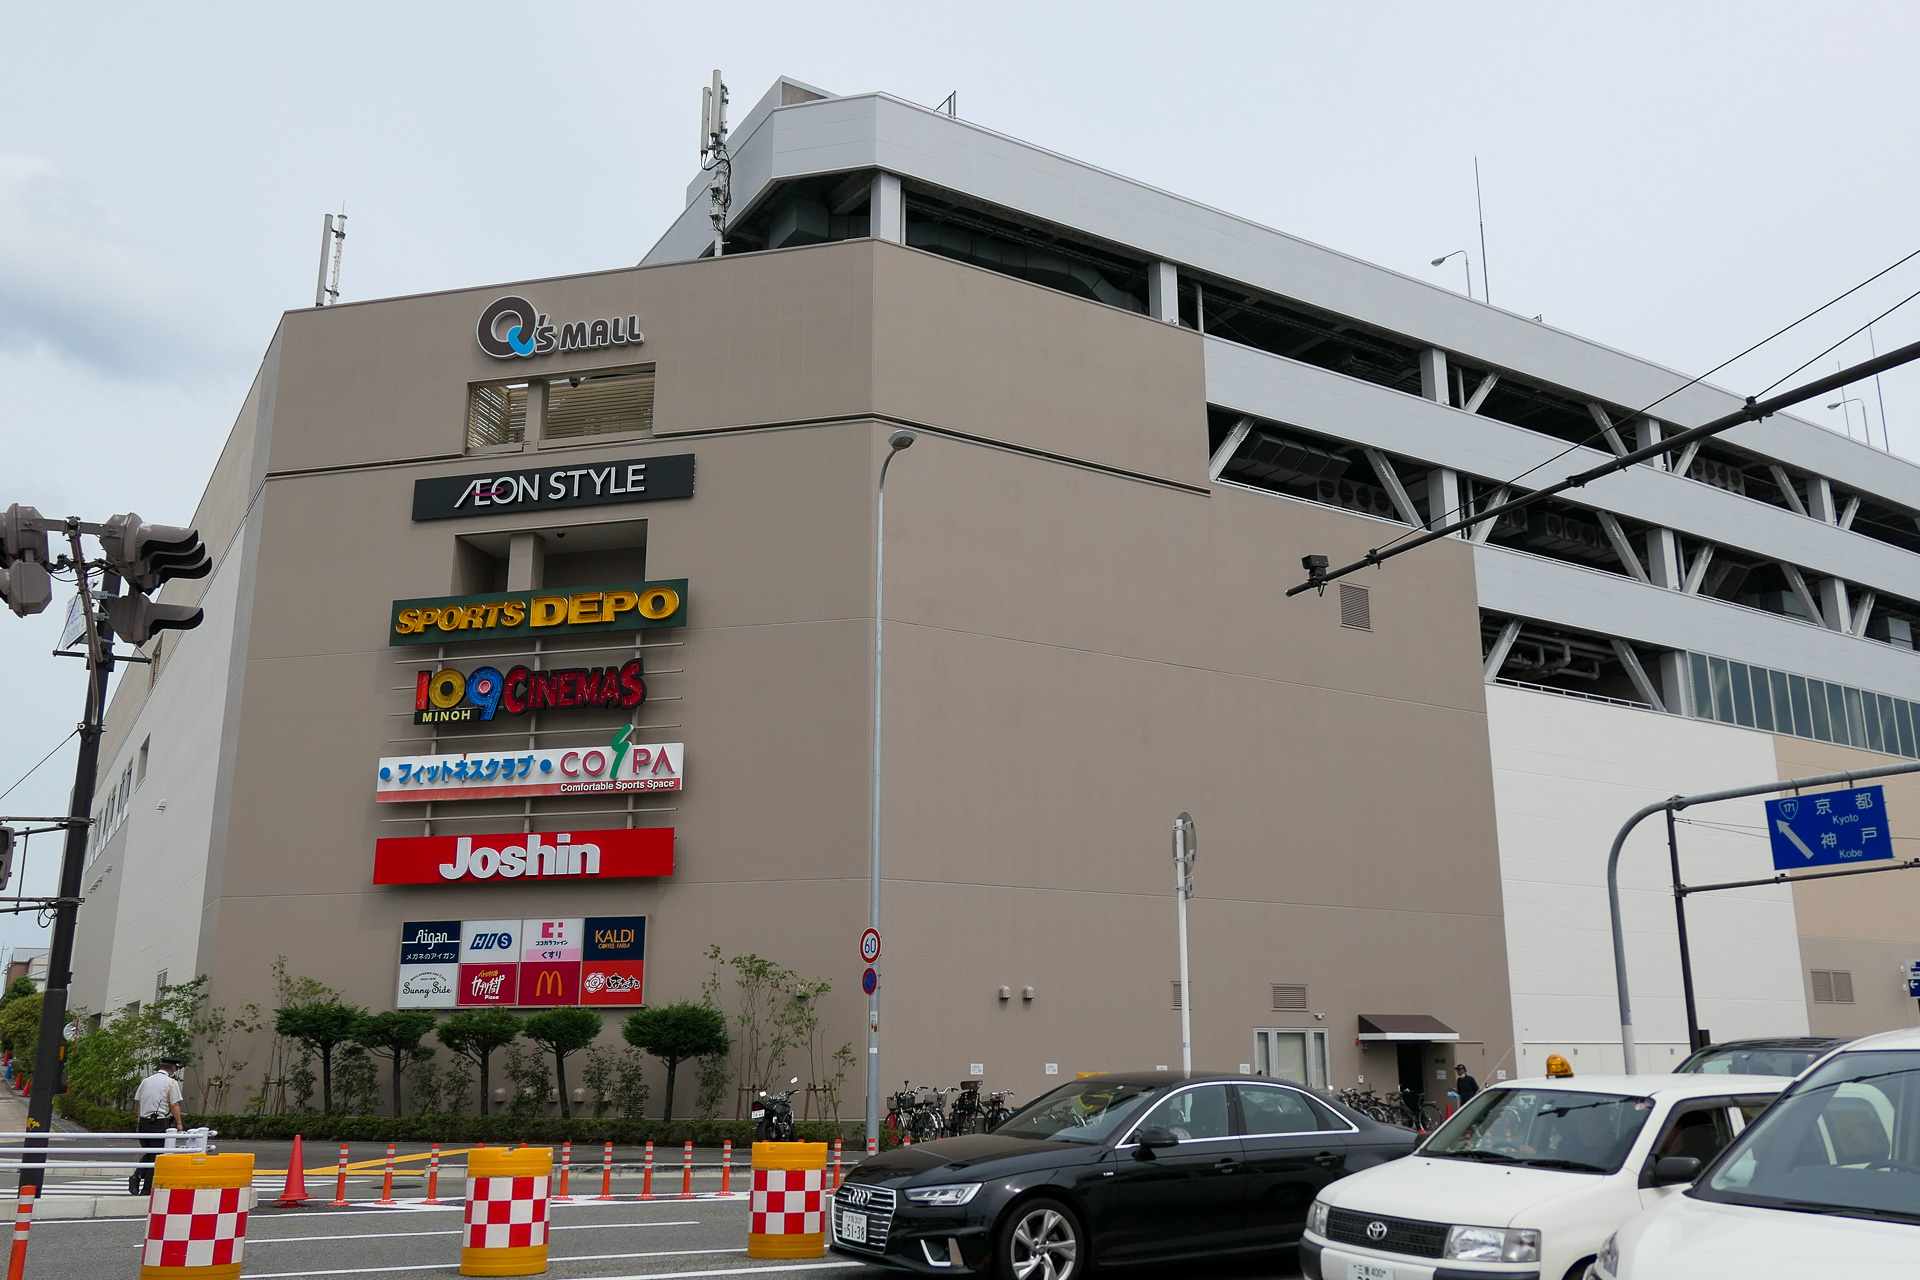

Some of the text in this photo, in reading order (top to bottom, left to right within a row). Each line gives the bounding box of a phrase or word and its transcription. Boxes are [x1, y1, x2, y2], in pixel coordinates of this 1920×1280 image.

[476, 295, 645, 358] Q's MALL
[547, 463, 647, 500] STYLE
[395, 586, 680, 635] SPORTS DEPO
[415, 657, 648, 721] 109 CINEMAS
[422, 709, 471, 723] MINOH
[398, 755, 535, 784] フィットネスクラブ
[560, 779, 675, 793] Comfortable Sports Space
[1783, 803, 1795, 813] 171
[1832, 813, 1859, 826] Kyoto
[438, 833, 602, 880] Joshin
[1839, 848, 1863, 858] Kobe
[415, 928, 448, 950] Aigan
[469, 932, 513, 950] HIS
[595, 929, 635, 943] KALDI
[865, 938, 876, 953] 60
[406, 952, 456, 961] メガネのアイガン
[541, 950, 562, 960] くすり
[402, 981, 452, 998] Sunny Side
[606, 973, 641, 990] はなまる
